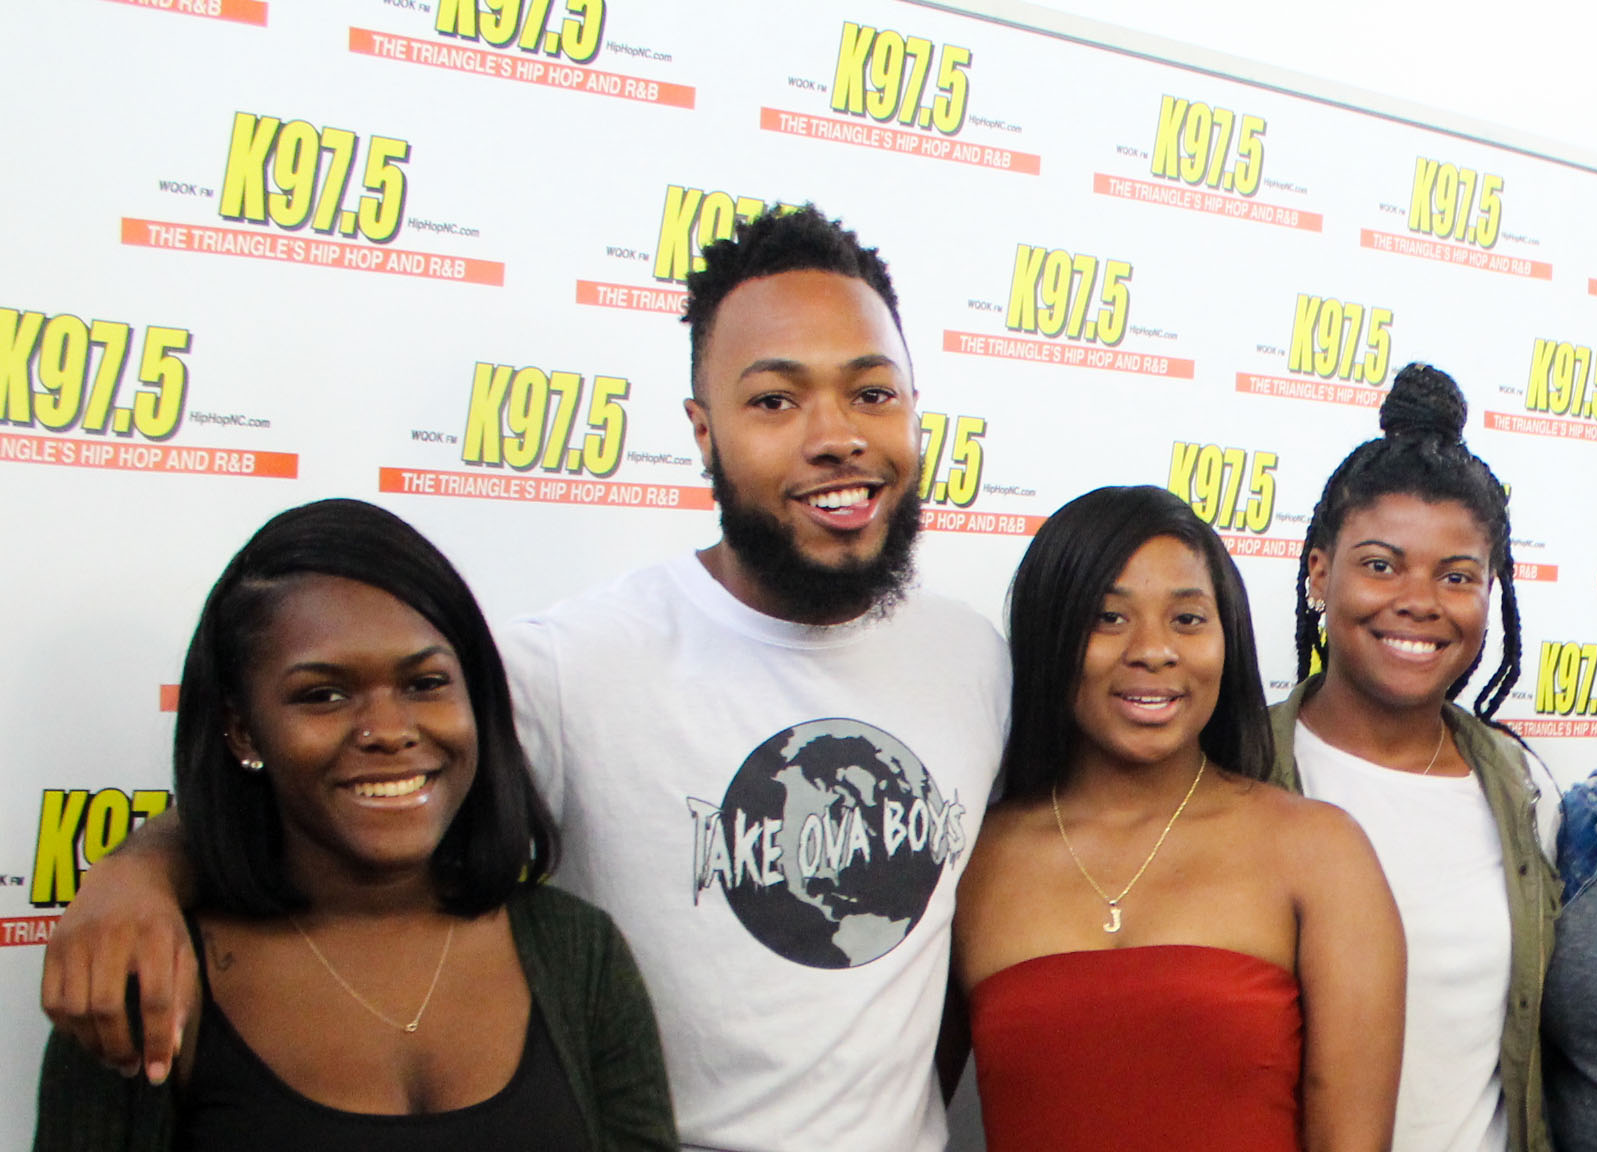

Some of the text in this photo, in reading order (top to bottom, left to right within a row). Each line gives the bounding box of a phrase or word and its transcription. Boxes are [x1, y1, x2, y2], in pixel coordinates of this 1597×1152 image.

[372, 34, 659, 101] THE TRIANGLE'S HIP HOP AND R&B
[606, 39, 673, 62] HipHopNC.com
[830, 20, 973, 137] K97.5
[779, 113, 1011, 168] THE TRIANGLE'S HIP HOP AND R&B
[1150, 94, 1267, 198] K97.5
[158, 180, 197, 196] WQOK
[219, 111, 412, 244] K97.5
[1108, 178, 1298, 226] THE TRIANGLE'S HIP HOP AND R&B
[1408, 156, 1504, 249] K97.5
[407, 217, 480, 238] HipHopNC.com
[147, 223, 466, 279] THE TRIANGLE'S HIP HOP AND R&B
[1373, 233, 1392, 249] THE
[1453, 248, 1468, 263] HIP
[1469, 253, 1488, 266] HOP
[1489, 256, 1509, 272] AND
[1512, 260, 1531, 275] R&B
[597, 286, 628, 307] THE
[1005, 243, 1133, 347] K97.5
[960, 335, 1168, 374] THE TRIANGLE'S HIP HOP AND R&B
[1287, 293, 1393, 387] K97.5
[0, 306, 194, 442] K97.5
[1250, 377, 1270, 393] THE
[1272, 380, 1334, 401] TRIANGLE'S
[1337, 388, 1353, 403] HIP
[1356, 391, 1377, 405] HOP
[190, 410, 270, 428] HipHopNC.com
[411, 429, 444, 443] WQOK
[462, 361, 632, 479] K97.5
[1493, 415, 1510, 430] THE
[1569, 425, 1584, 439] HIP
[80, 444, 114, 466] HIP
[120, 447, 162, 468] HOP
[166, 450, 209, 470] AND
[214, 453, 255, 473] R&B
[627, 451, 692, 466] HipHopNC.com
[401, 472, 679, 506] THE TRIANGLE'S HIP HOP AND R&B
[1168, 441, 1279, 533] K97.5
[937, 513, 966, 529] HOP
[967, 516, 995, 531] AND
[998, 517, 1025, 532] R&B
[1237, 540, 1261, 554] HOP
[1262, 541, 1286, 556] AND
[1573, 723, 1588, 736] HIP
[686, 796, 784, 907] TAKE
[799, 802, 870, 888] OVA
